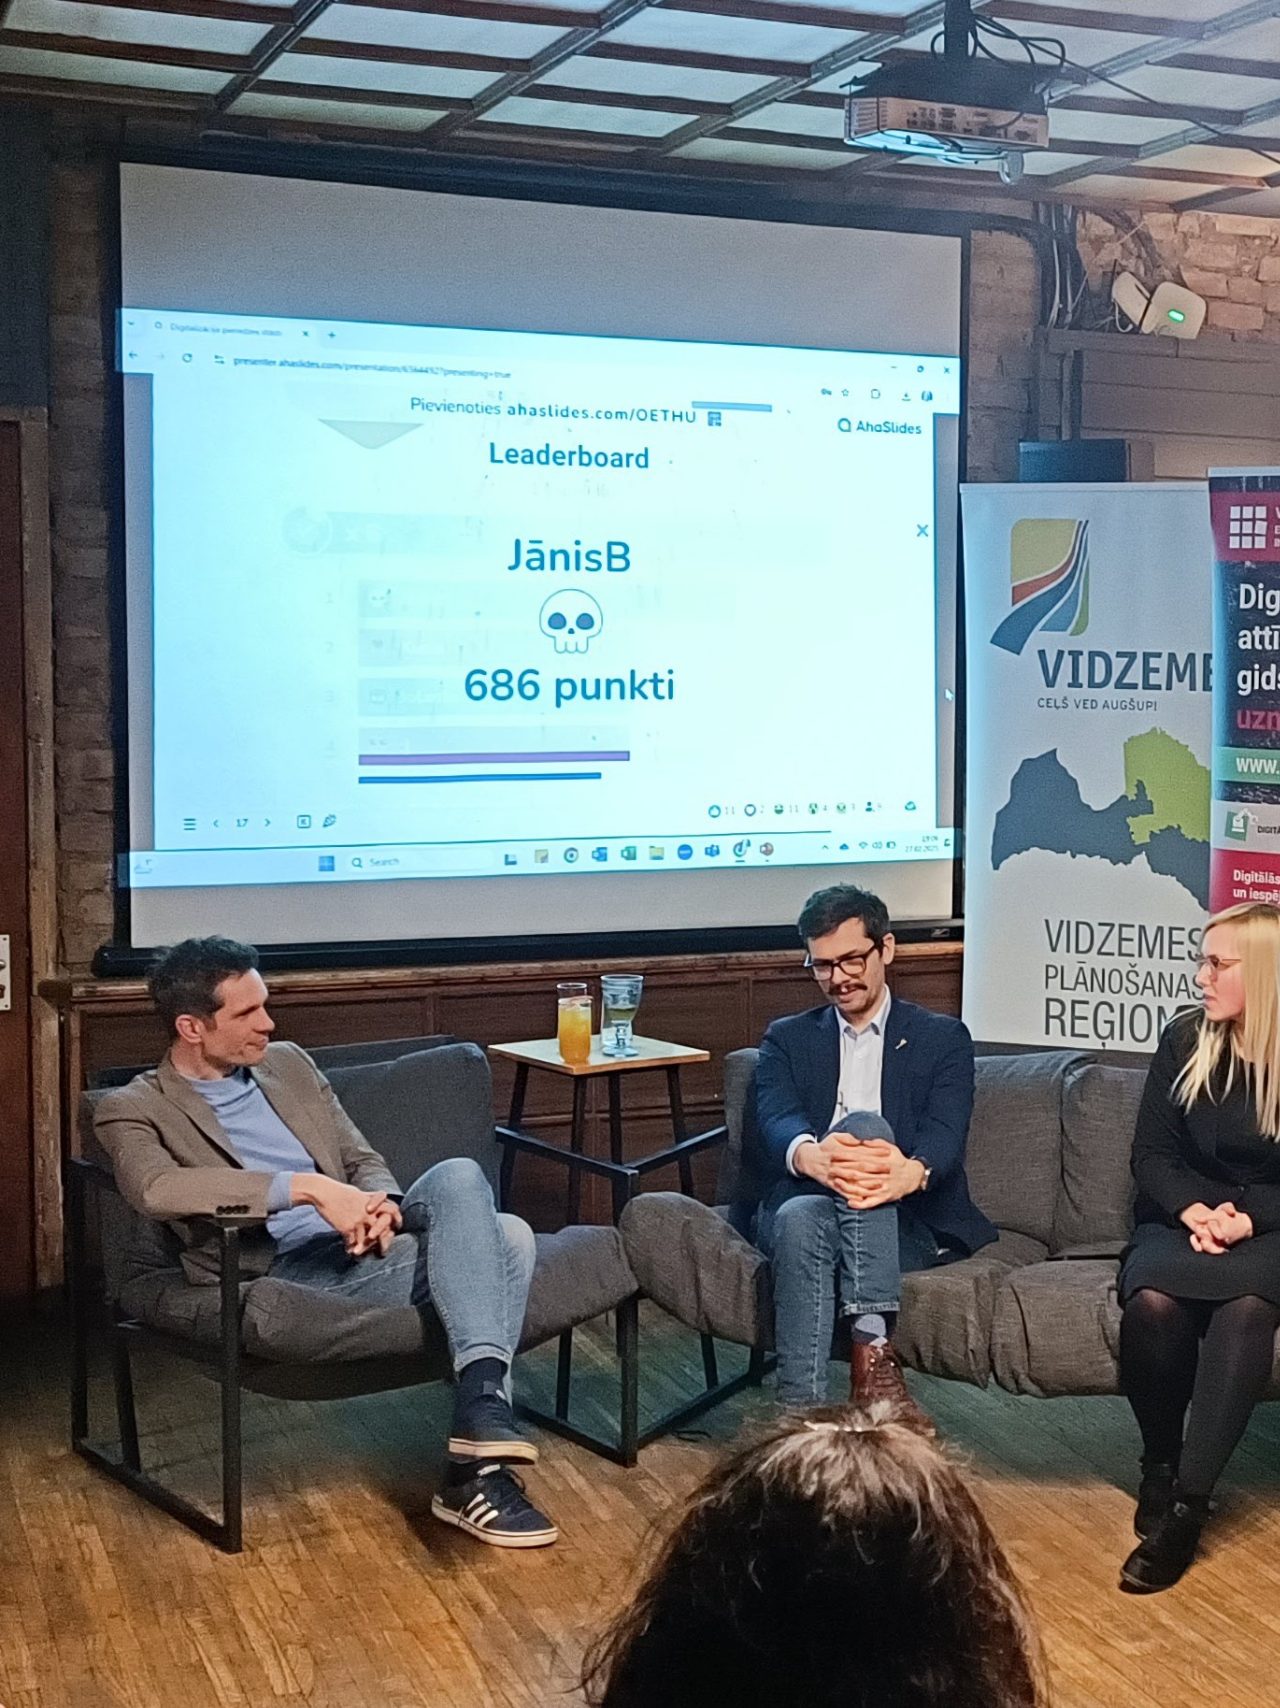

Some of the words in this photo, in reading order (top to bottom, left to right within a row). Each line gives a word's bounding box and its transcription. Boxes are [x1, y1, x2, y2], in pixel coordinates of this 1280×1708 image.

[410, 397, 501, 415] Pievienoties
[507, 402, 697, 423] ahaslides.com/OETHU
[856, 420, 923, 435] AhaSlides
[489, 442, 649, 469] Leaderboard
[507, 538, 632, 573] JānisB
[1037, 649, 1213, 692] VIDZEME
[464, 668, 541, 701] 686
[555, 669, 675, 708] punkti
[1037, 696, 1070, 711] CEĻŠ
[1073, 698, 1099, 710] VED
[1232, 888, 1247, 899] un
[1044, 919, 1201, 962] VIDZEMES
[1045, 961, 1205, 1001] PLĀNOŠANAS
